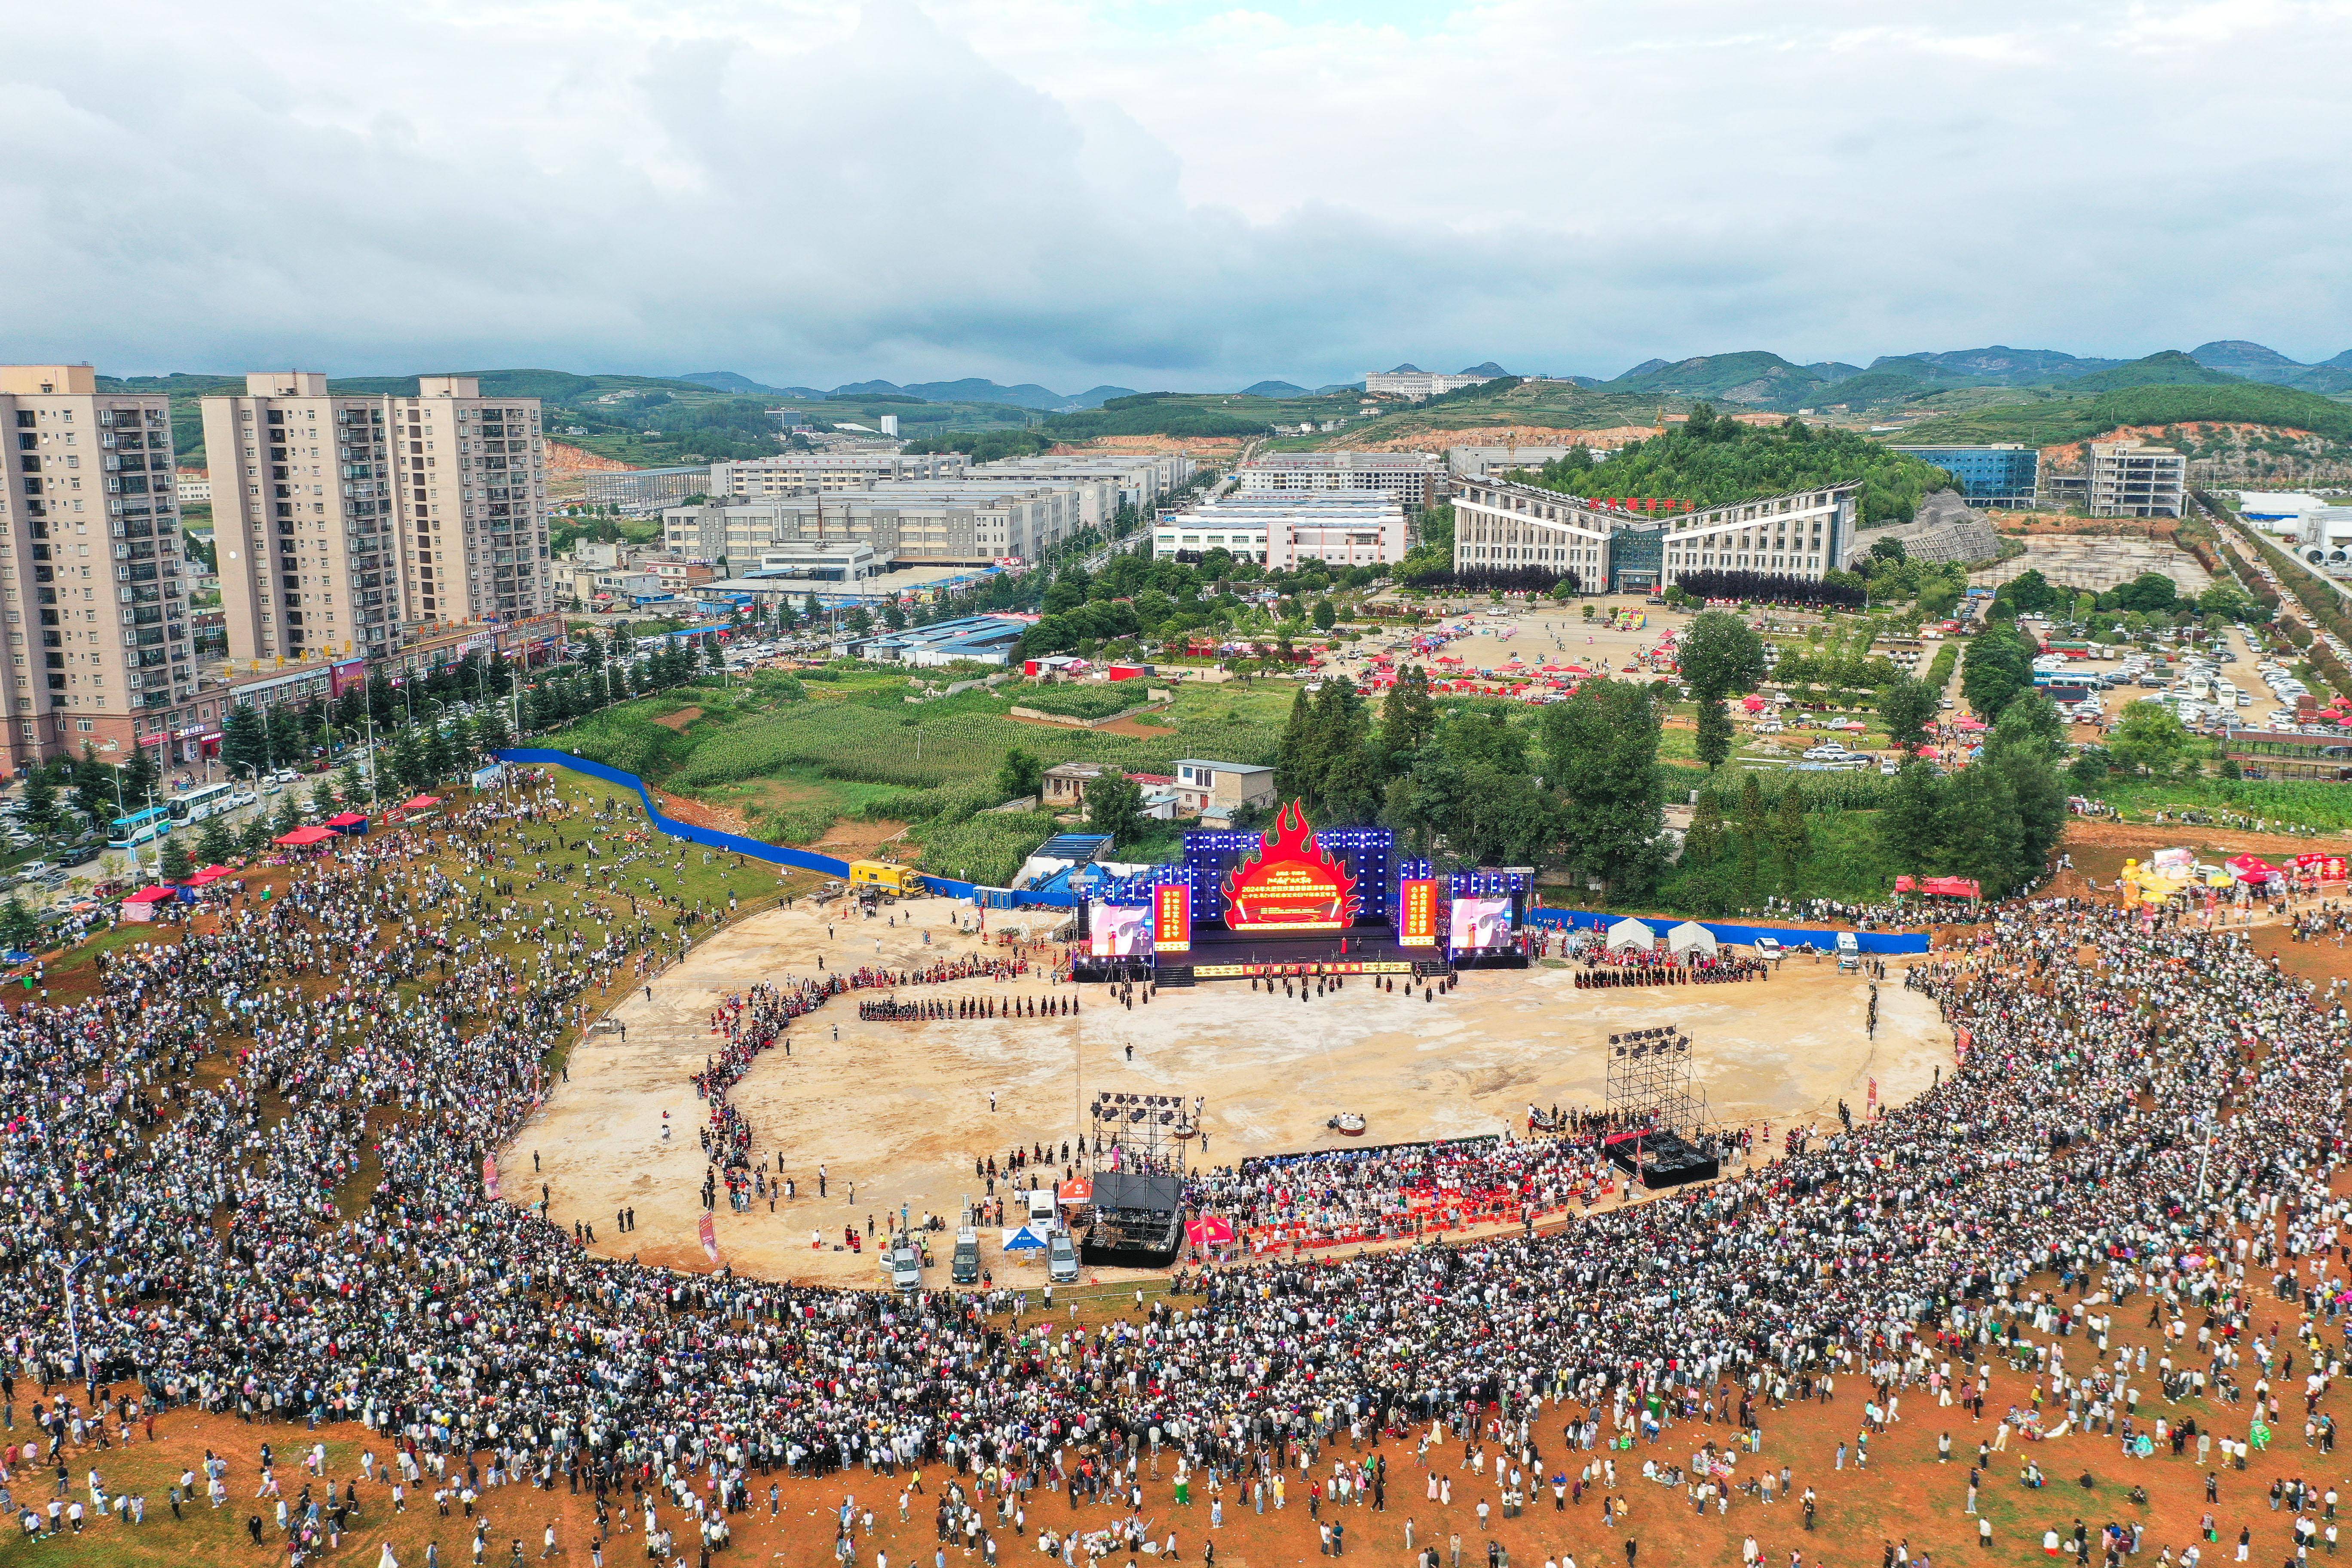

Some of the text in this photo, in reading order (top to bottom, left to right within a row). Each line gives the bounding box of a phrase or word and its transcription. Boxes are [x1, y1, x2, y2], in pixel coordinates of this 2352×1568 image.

[1589, 497, 1695, 511] 政务服务中心
